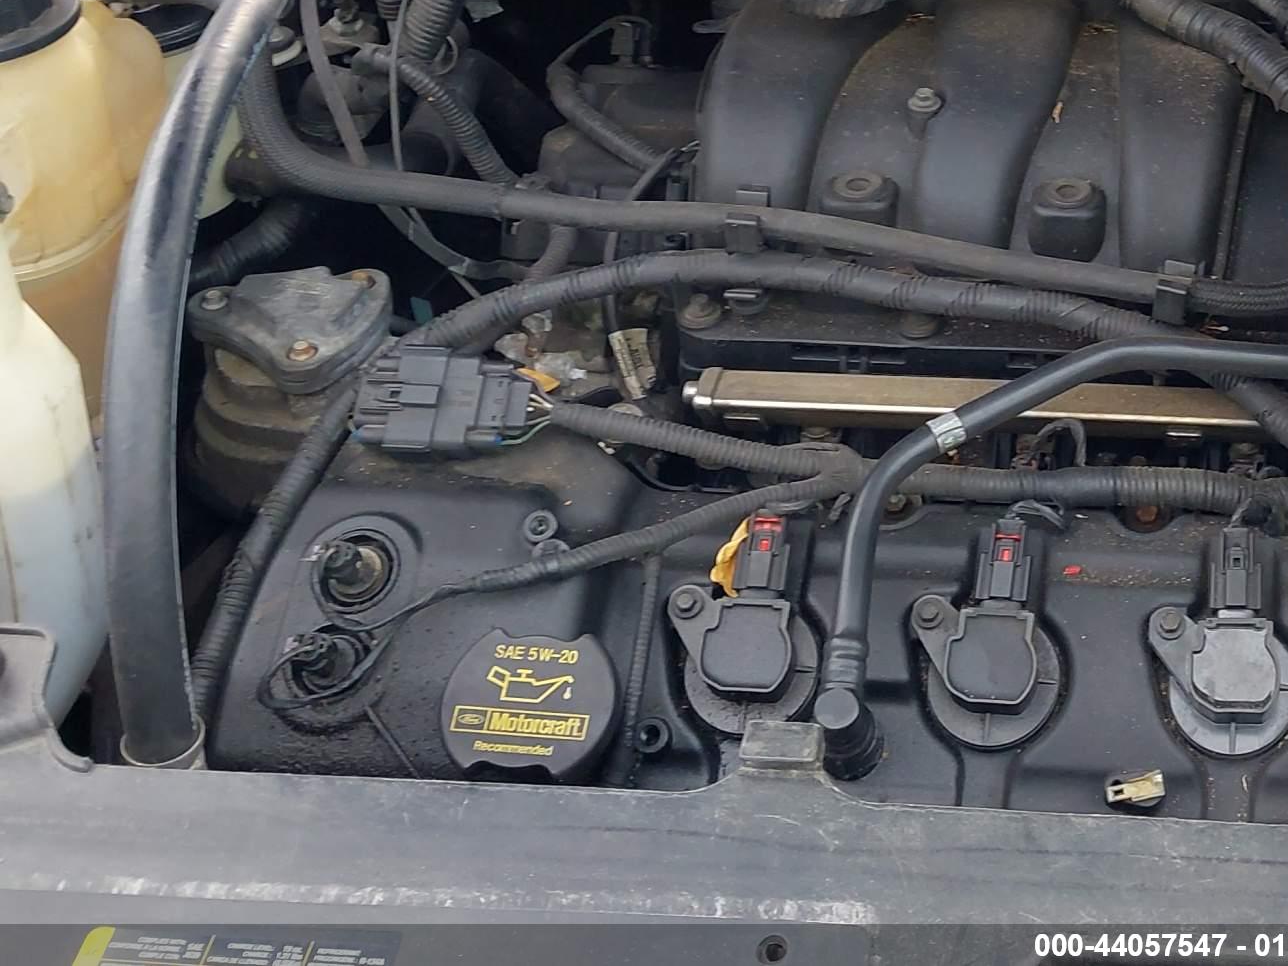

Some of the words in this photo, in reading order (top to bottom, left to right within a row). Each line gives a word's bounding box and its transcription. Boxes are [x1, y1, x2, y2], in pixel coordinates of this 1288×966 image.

[495, 645, 524, 660] SAE
[528, 647, 579, 664] 5W-20
[490, 712, 580, 736] Motorcraft
[473, 740, 553, 756] Recommended
